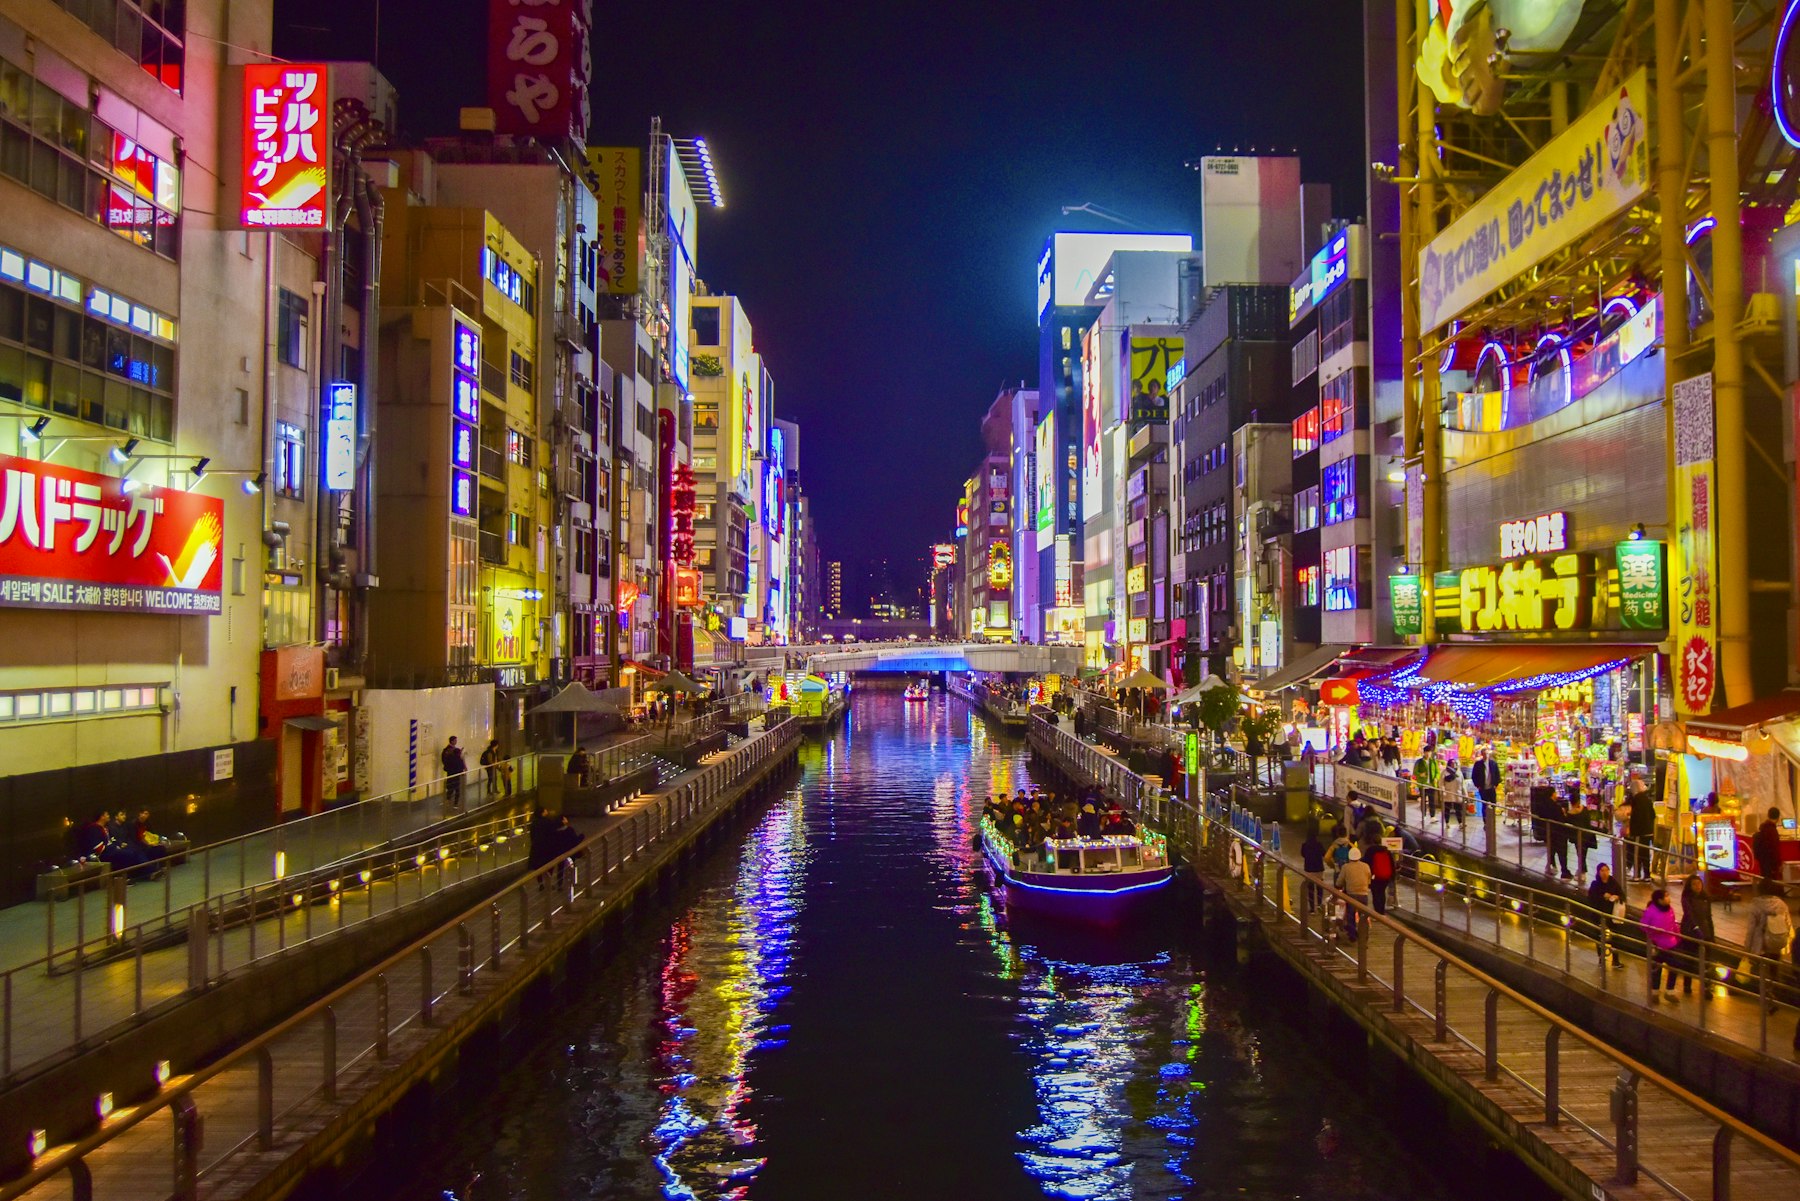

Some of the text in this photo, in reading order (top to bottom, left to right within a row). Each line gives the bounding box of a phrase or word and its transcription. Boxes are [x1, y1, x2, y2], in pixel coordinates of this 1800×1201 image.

[506, 0, 561, 124] らや
[283, 73, 318, 163] ツルハ
[252, 88, 283, 187] ドラッグ
[1621, 554, 1657, 590] 薬
[1, 579, 41, 602] 세일판매
[43, 583, 74, 604] SALE
[103, 587, 143, 607] 환영합니다
[145, 590, 193, 610] WELCOME
[1394, 584, 1418, 608] 薬
[1687, 647, 1709, 675] すぐ
[1687, 676, 1707, 703] そこ
